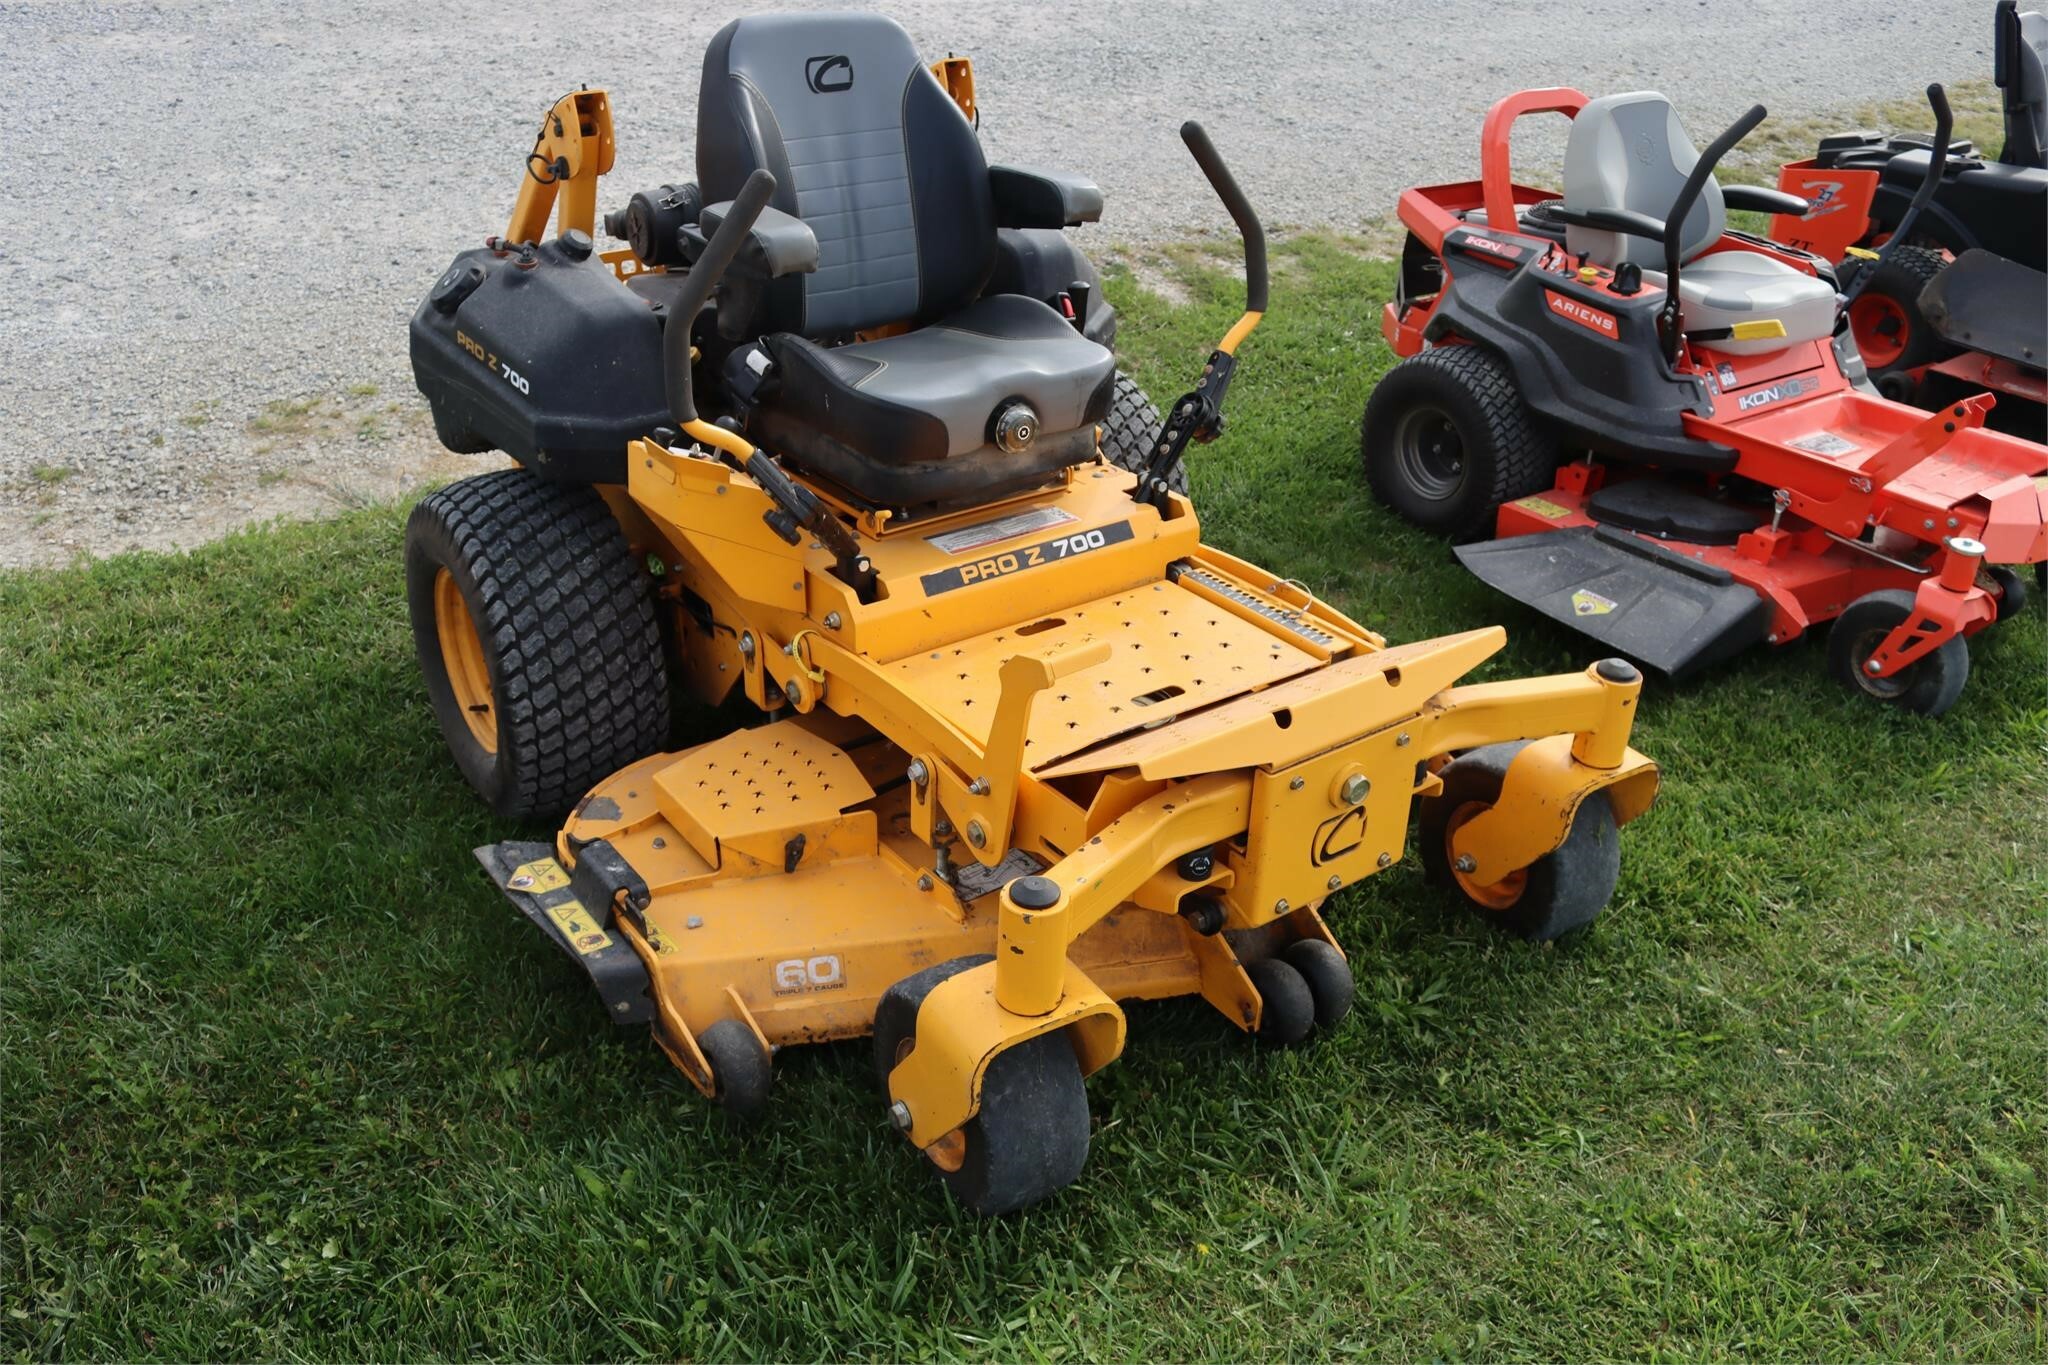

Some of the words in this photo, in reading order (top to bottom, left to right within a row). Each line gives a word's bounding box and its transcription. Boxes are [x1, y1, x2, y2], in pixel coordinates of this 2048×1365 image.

[1553, 298, 1613, 330] ARIENS
[457, 330, 484, 361] PRO
[488, 353, 498, 371] Z
[501, 362, 530, 395] 700
[959, 554, 1019, 585] PRO
[1024, 546, 1045, 566] Z
[1052, 530, 1106, 557] 700
[776, 955, 841, 988] 60
